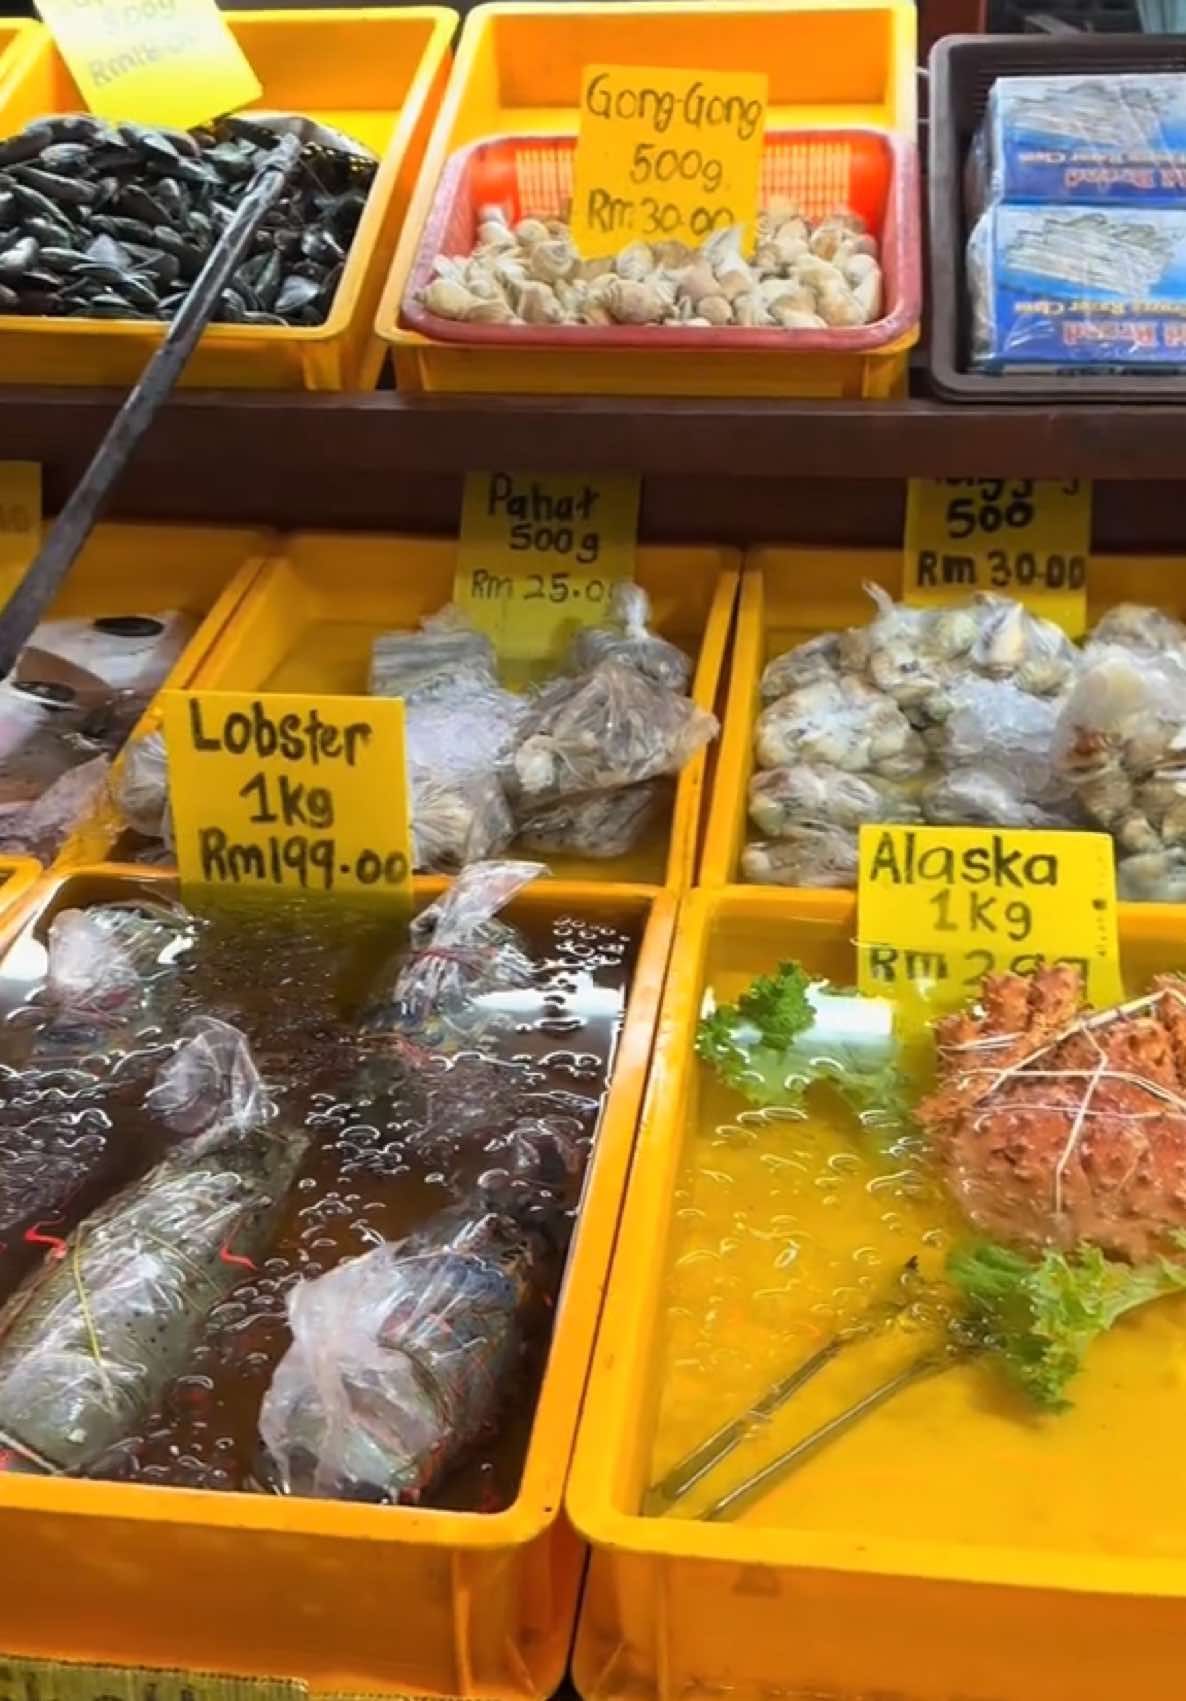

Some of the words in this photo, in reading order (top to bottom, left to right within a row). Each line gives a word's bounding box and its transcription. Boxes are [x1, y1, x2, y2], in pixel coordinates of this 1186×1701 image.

[586, 72, 763, 141] Gong-Gong
[629, 143, 723, 193] 500g
[488, 472, 600, 520] Pahat
[947, 498, 1034, 538] 500
[509, 523, 599, 564] 500g
[472, 568, 513, 598] Rm
[523, 572, 612, 603] 25.0
[917, 550, 976, 587] Rm
[987, 549, 1086, 589] 30.00
[189, 697, 372, 766] Lobster
[239, 772, 335, 829] 1kg
[870, 831, 1058, 888] Alaska
[870, 946, 948, 982] Rm
